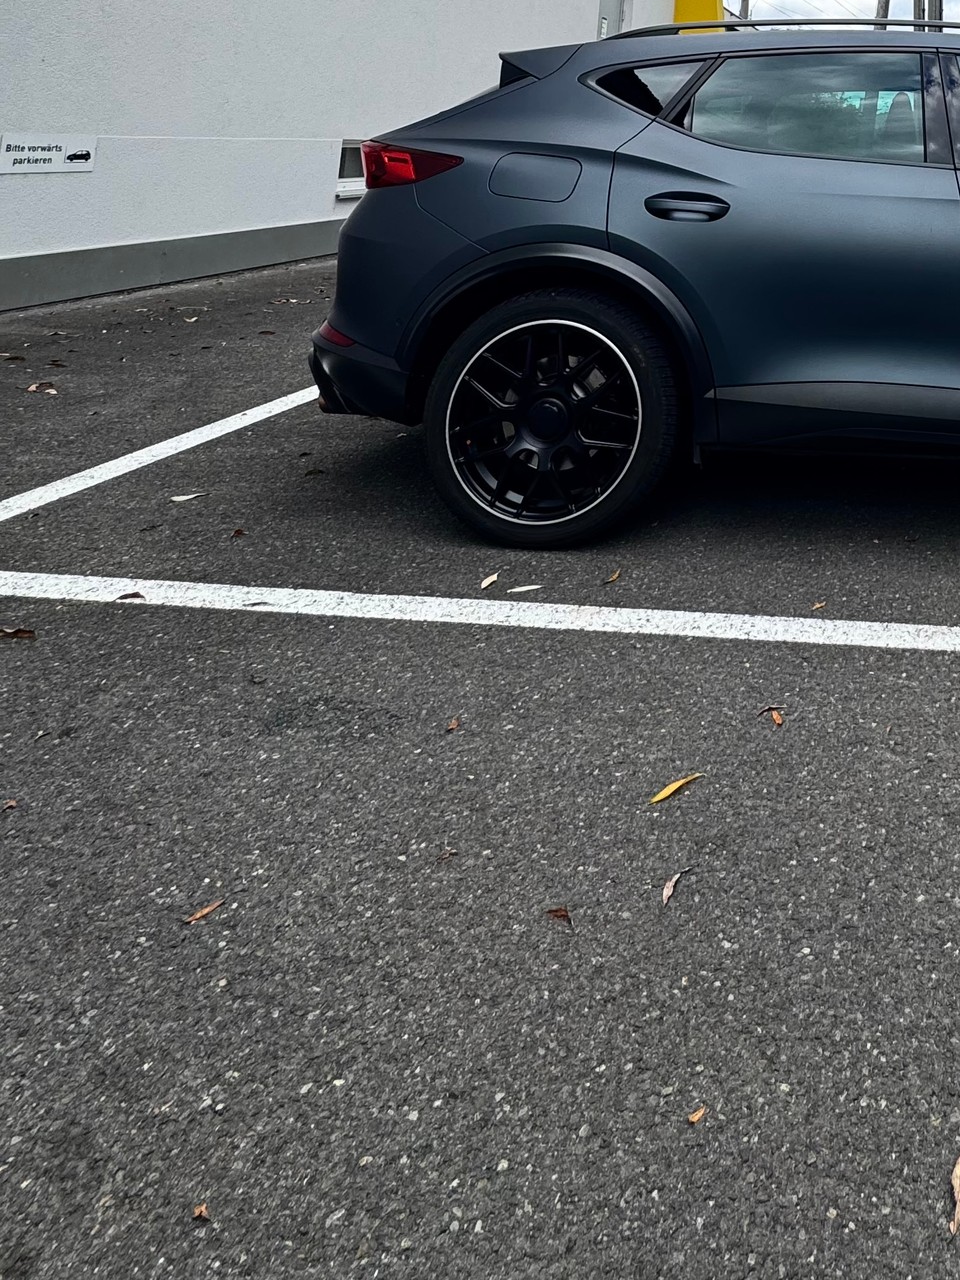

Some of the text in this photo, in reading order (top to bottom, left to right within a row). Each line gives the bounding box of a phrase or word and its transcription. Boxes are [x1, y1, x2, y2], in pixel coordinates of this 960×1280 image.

[5, 143, 63, 153] Bitte vorwärts
[12, 156, 53, 167] parkieren
